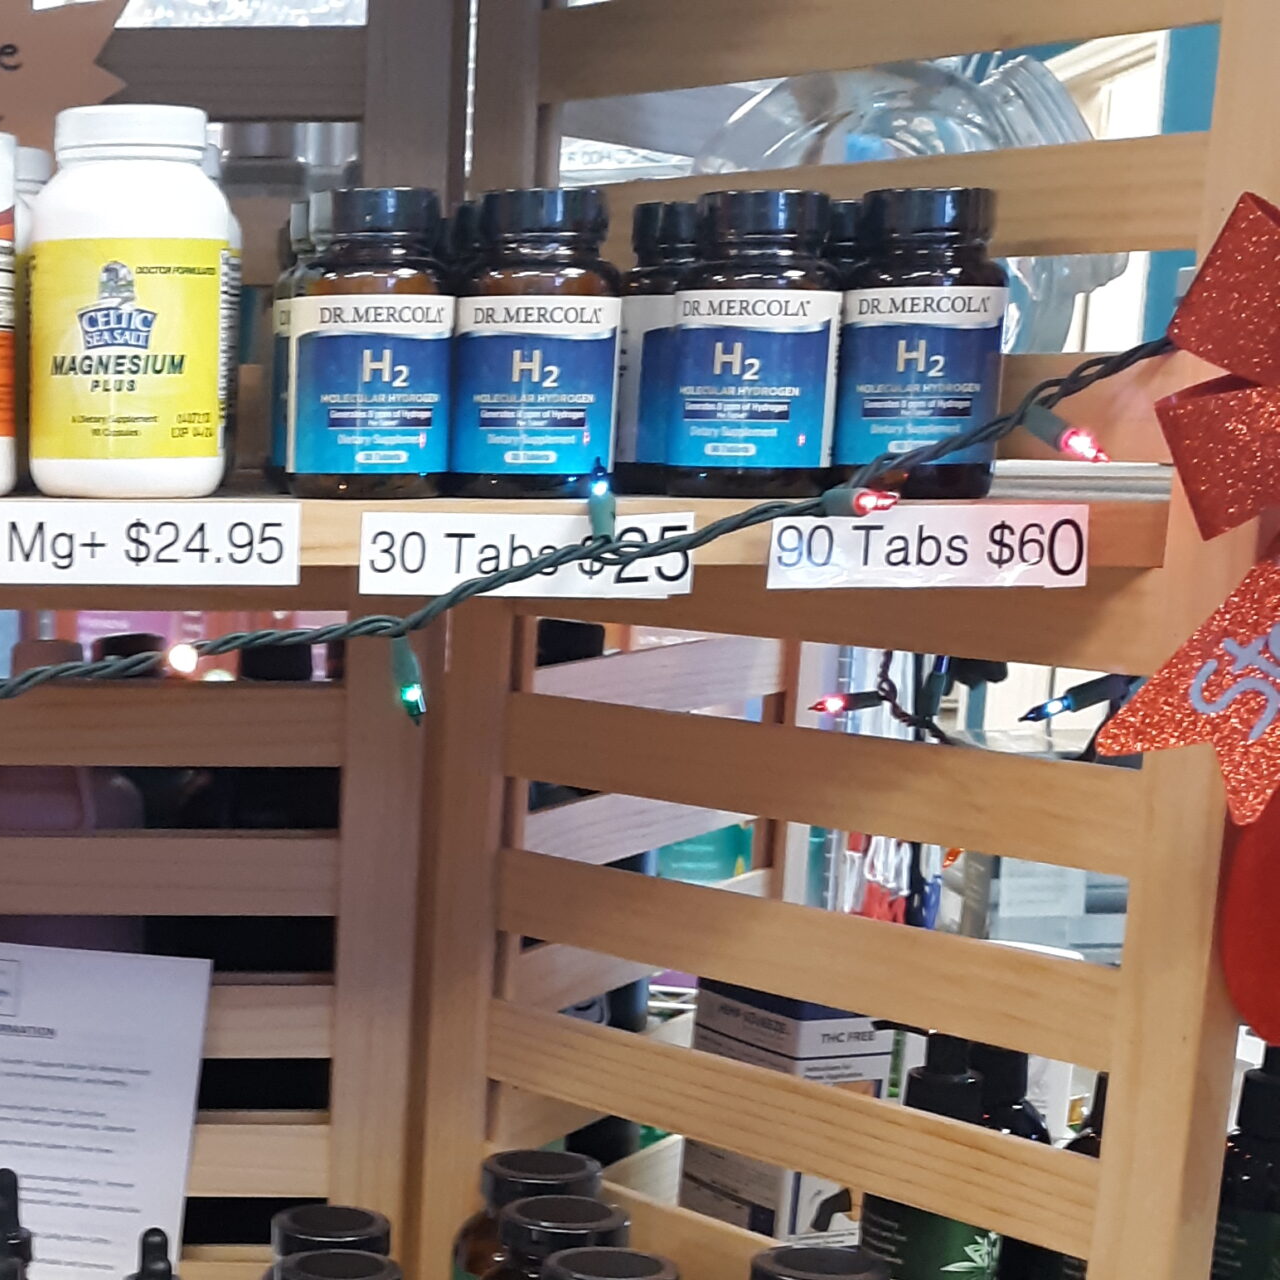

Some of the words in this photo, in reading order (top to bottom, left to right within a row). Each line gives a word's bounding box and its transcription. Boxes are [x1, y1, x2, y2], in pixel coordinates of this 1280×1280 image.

[708, 300, 808, 317] MERCOLA
[888, 295, 990, 313] MERCOLA
[82, 310, 152, 331] CELTIC
[353, 306, 445, 324] MERCOLA
[504, 306, 602, 324] MERCOLA
[86, 330, 112, 346] SEA
[112, 330, 149, 347] SALT
[50, 355, 186, 376] MAGNESIUM
[362, 349, 410, 387] H2
[512, 349, 559, 387] H2
[713, 342, 760, 381] H2
[896, 340, 944, 378] H2
[91, 379, 137, 392] PLUS
[738, 386, 800, 397] HYDROGEN
[922, 383, 981, 393] HYDROGEN
[388, 394, 440, 404] HYDROGEN
[537, 394, 595, 404] HYDROGEN
[6, 521, 106, 569] Mg+
[124, 518, 284, 567] $24.95
[369, 530, 426, 574] 30
[776, 524, 834, 567] 90
[852, 524, 969, 567] Tabs
[987, 518, 1084, 577] $60
[822, 1033, 845, 1044] THC
[847, 1031, 877, 1043] FREE
